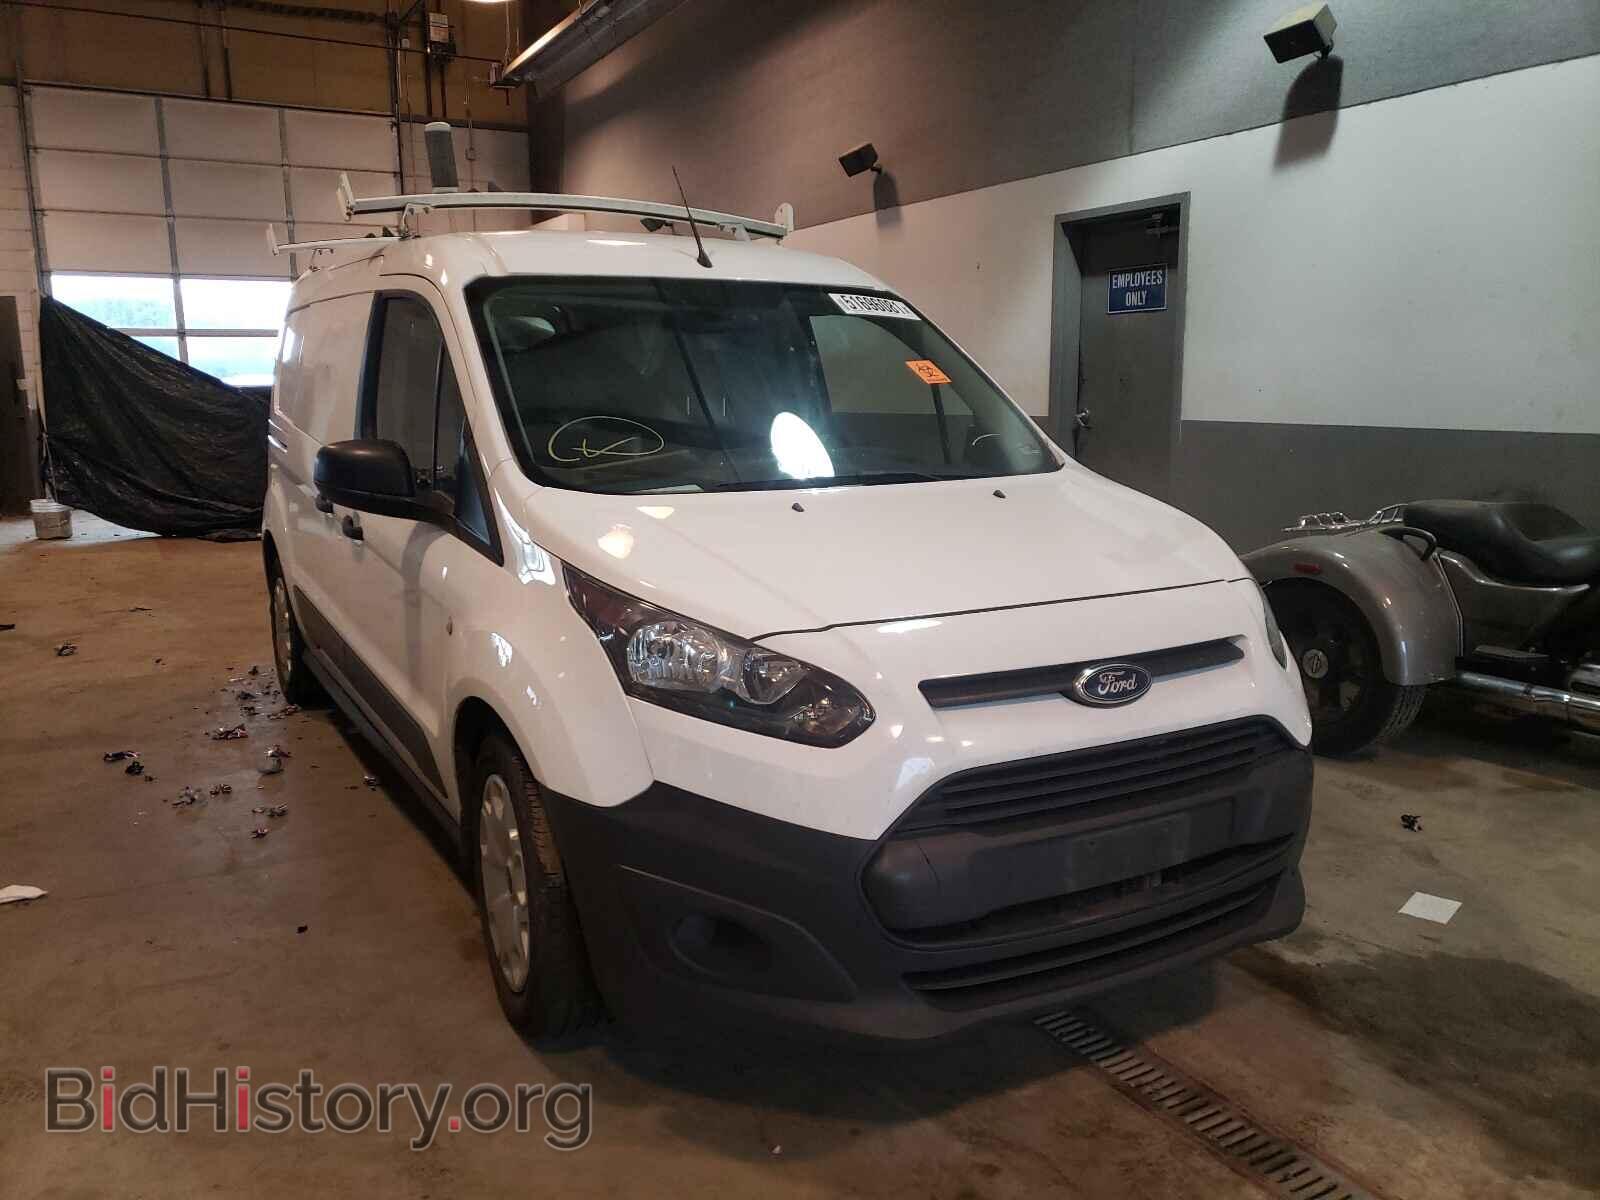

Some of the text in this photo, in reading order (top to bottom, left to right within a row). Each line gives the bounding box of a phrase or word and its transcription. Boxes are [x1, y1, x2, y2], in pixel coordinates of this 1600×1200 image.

[1112, 270, 1163, 288] EMPLOYEES
[1125, 290, 1147, 306] ONLY
[1097, 671, 1138, 695] Ford
